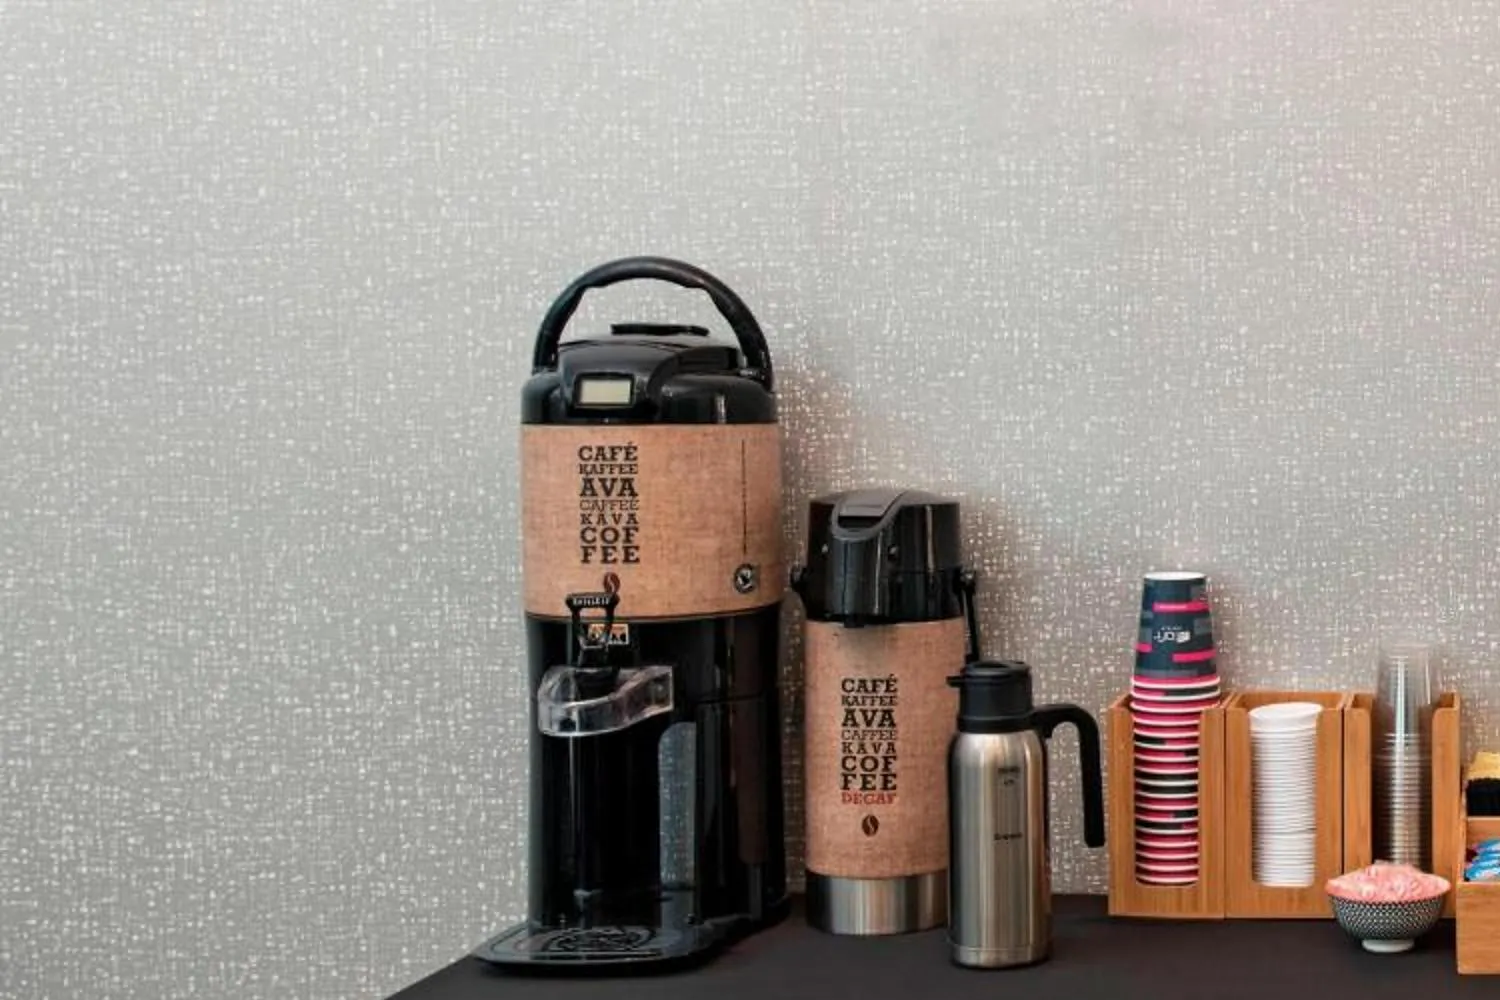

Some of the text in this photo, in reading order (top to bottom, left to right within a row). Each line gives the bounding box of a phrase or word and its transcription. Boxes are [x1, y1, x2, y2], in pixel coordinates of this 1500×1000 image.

[578, 441, 639, 461] CAFÉ
[579, 463, 639, 474] KAFFEE
[580, 526, 639, 544] COF
[580, 545, 640, 564] FEE
[841, 673, 898, 693] CAFÉ
[841, 708, 897, 728] AVA
[841, 755, 897, 772] COF
[841, 773, 897, 791] FEE
[841, 792, 897, 804] DECAF
